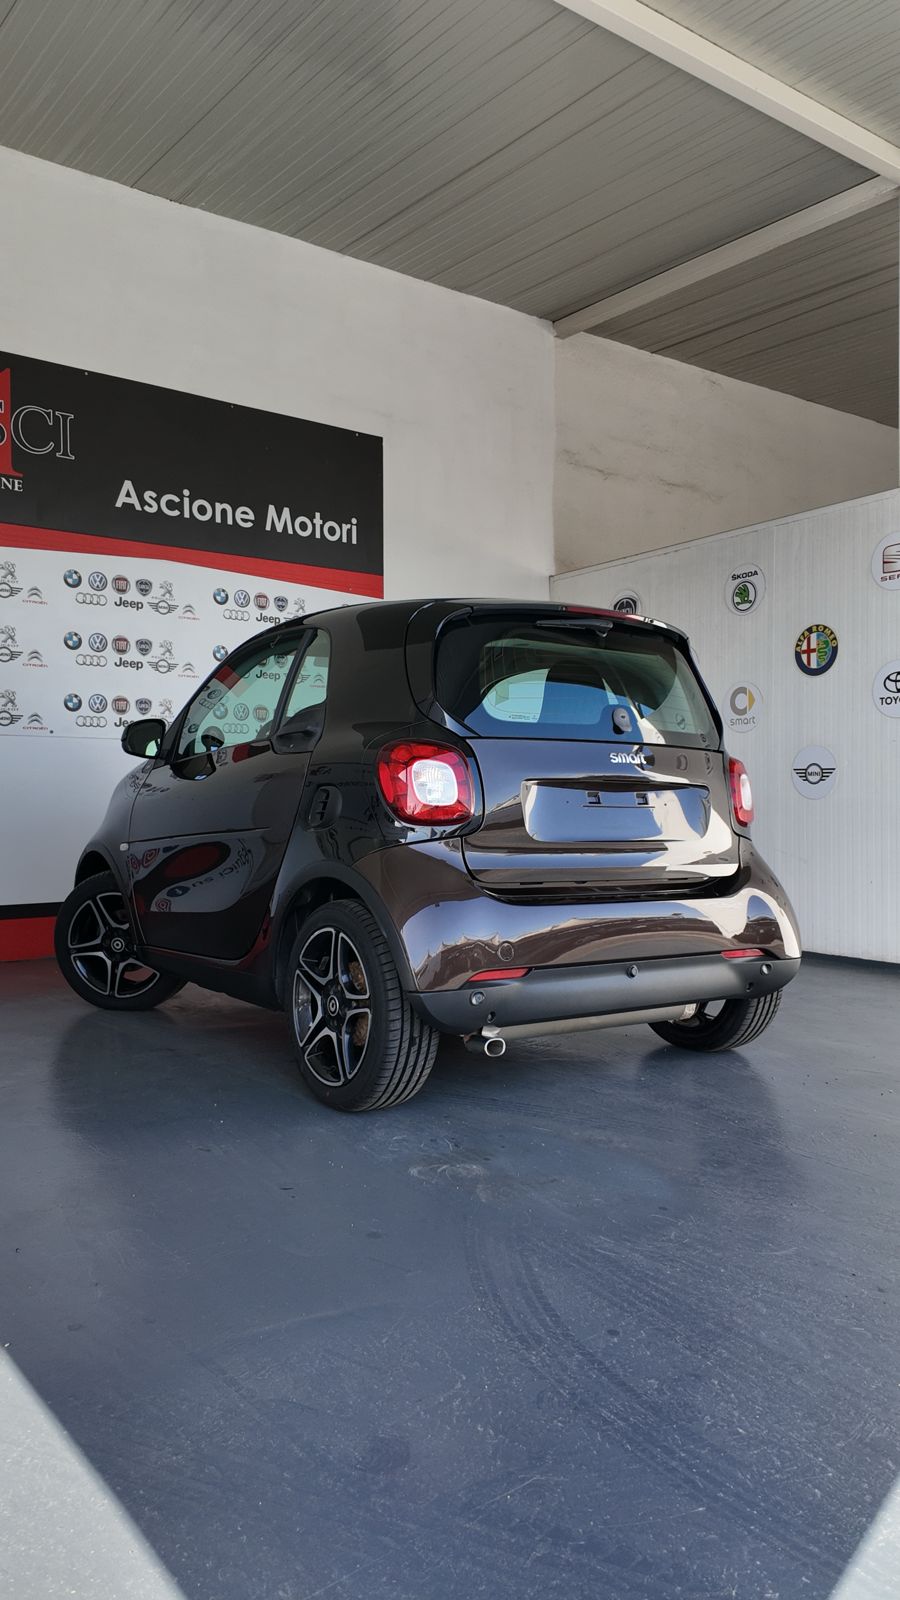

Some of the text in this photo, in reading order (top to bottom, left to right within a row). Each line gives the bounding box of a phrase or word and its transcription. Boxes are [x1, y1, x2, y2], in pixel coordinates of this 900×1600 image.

[115, 480, 358, 545] Ascione Motori
[114, 597, 144, 612] Jeep
[256, 613, 281, 626] Jeep
[811, 625, 838, 647] ROMEO
[114, 657, 144, 672] Jeep
[256, 670, 280, 682] Jeep
[879, 696, 900, 706] TOY
[730, 715, 756, 726] smart
[610, 752, 646, 765] smart
